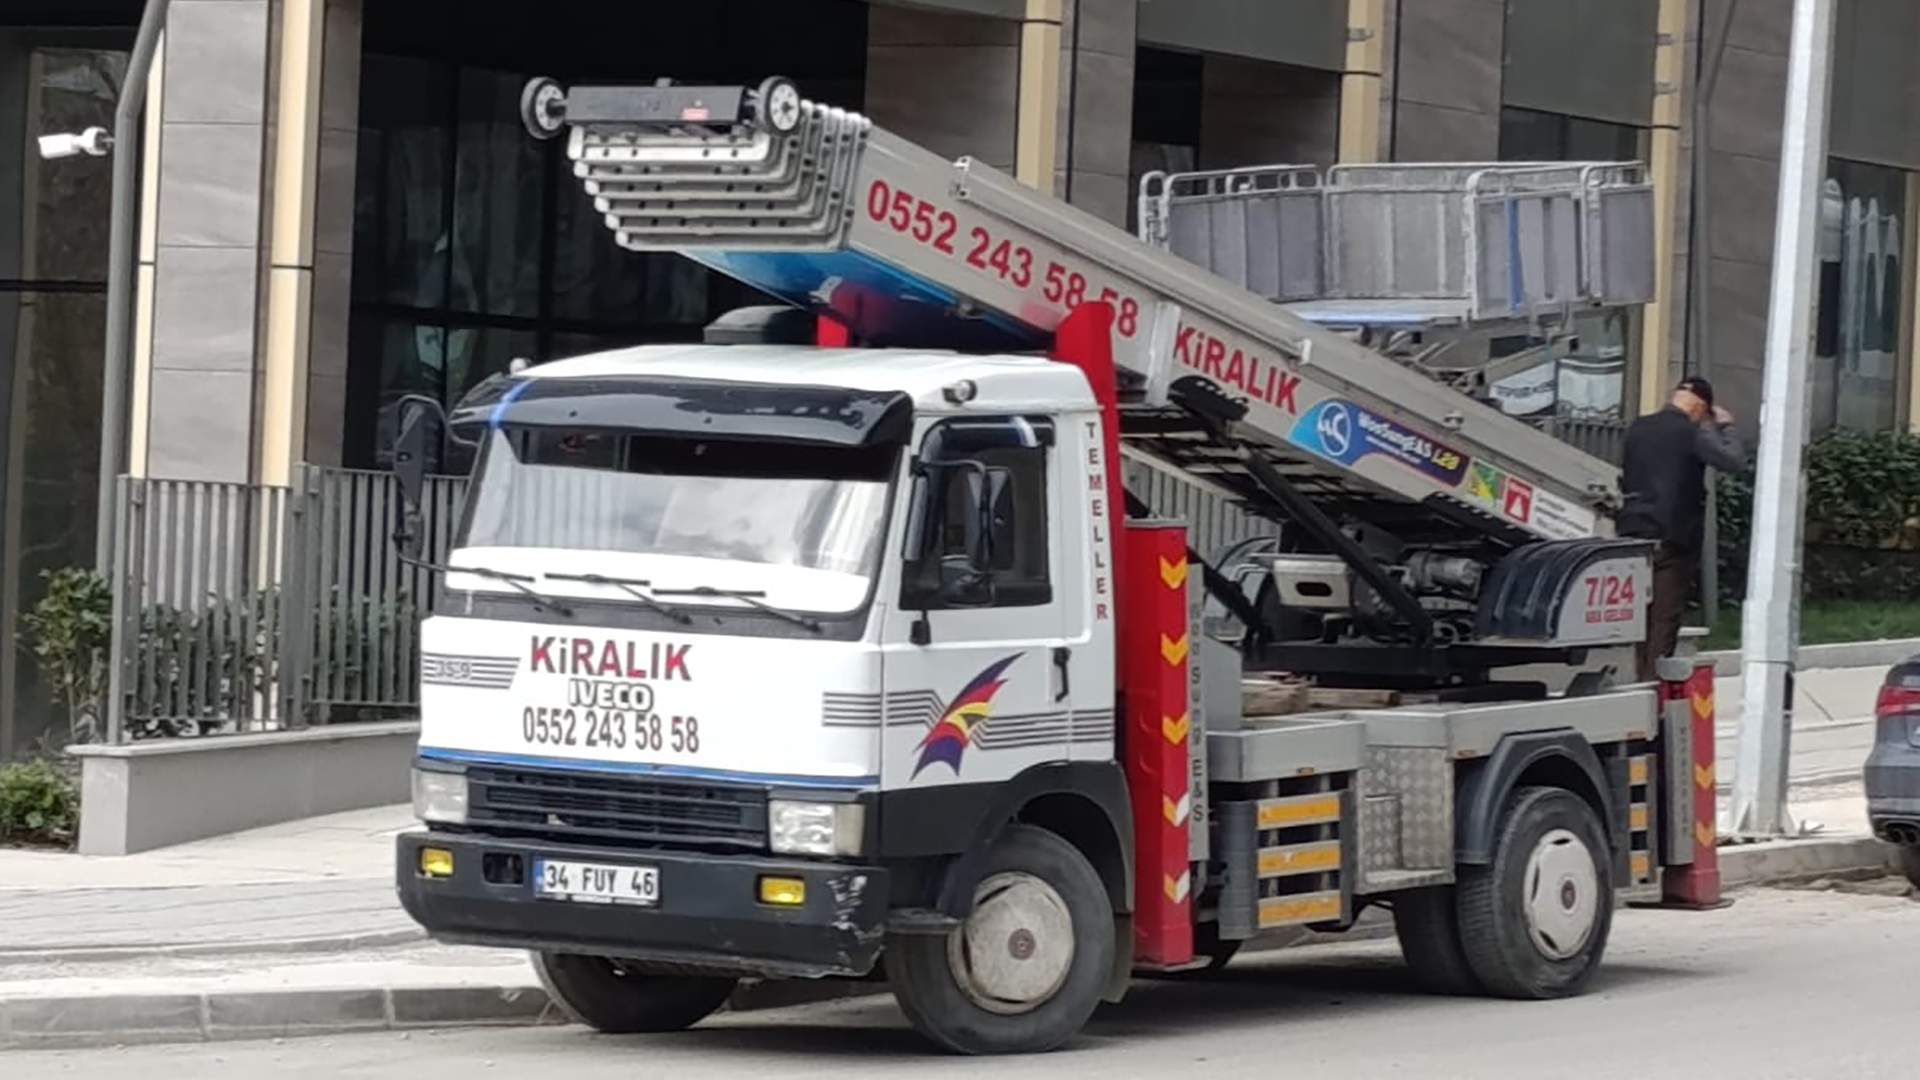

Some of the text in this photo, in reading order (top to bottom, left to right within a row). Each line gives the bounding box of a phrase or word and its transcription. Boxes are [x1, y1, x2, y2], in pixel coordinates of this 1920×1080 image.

[867, 179, 958, 256] 0552
[965, 226, 1034, 288] 243
[1042, 261, 1087, 310] 58
[1084, 421, 1108, 620] TEMELLER
[1585, 573, 1635, 608] 7/24
[567, 677, 655, 713] IVECO
[522, 705, 700, 754] 0552 243 58 58
[546, 864, 655, 897] 34 FUY 46
